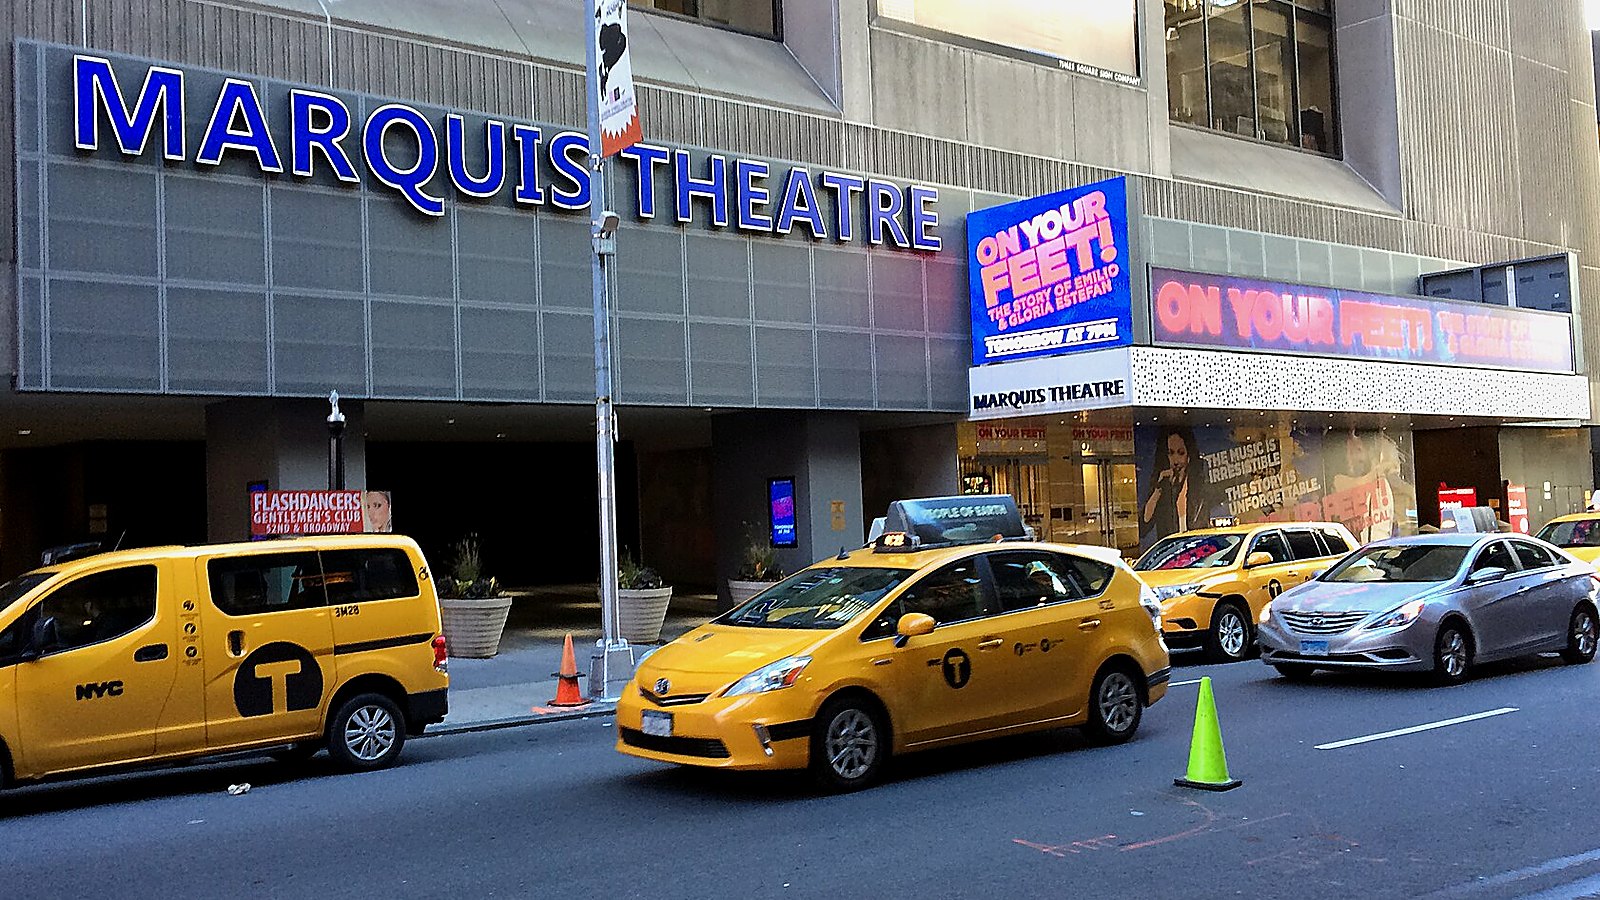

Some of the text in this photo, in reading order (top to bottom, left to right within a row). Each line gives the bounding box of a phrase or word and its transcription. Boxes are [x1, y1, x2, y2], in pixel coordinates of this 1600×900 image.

[1114, 73, 1141, 86] COMPANY
[73, 54, 942, 251] MARQUIS THEATRE
[977, 190, 1109, 266] ON YOUR
[981, 217, 1118, 308] FEET!
[988, 264, 1120, 323] THE STORY OF EMILIO
[998, 280, 1113, 331] & GLORIA ESTEFAN
[1157, 281, 1223, 336] ON
[1227, 288, 1335, 345] YOUR
[1066, 327, 1085, 342] AT
[1086, 323, 1116, 339] 7PM
[974, 380, 1124, 409] MARQUIS THEATRE
[978, 428, 992, 438] ON
[995, 428, 1019, 438] YOUR
[1204, 438, 1277, 468] THE MUSIC IS
[1208, 452, 1281, 484] IRRESISTIBLE
[1225, 469, 1297, 502] THE STORY IS
[253, 492, 361, 512] FLASHDANCERS
[960, 506, 974, 517] OF
[253, 510, 361, 524] GENTLEMEN'S CLUB
[266, 522, 351, 534] 52ND & BROADWAY
[335, 605, 360, 617] 3M28
[75, 680, 124, 701] NYC
